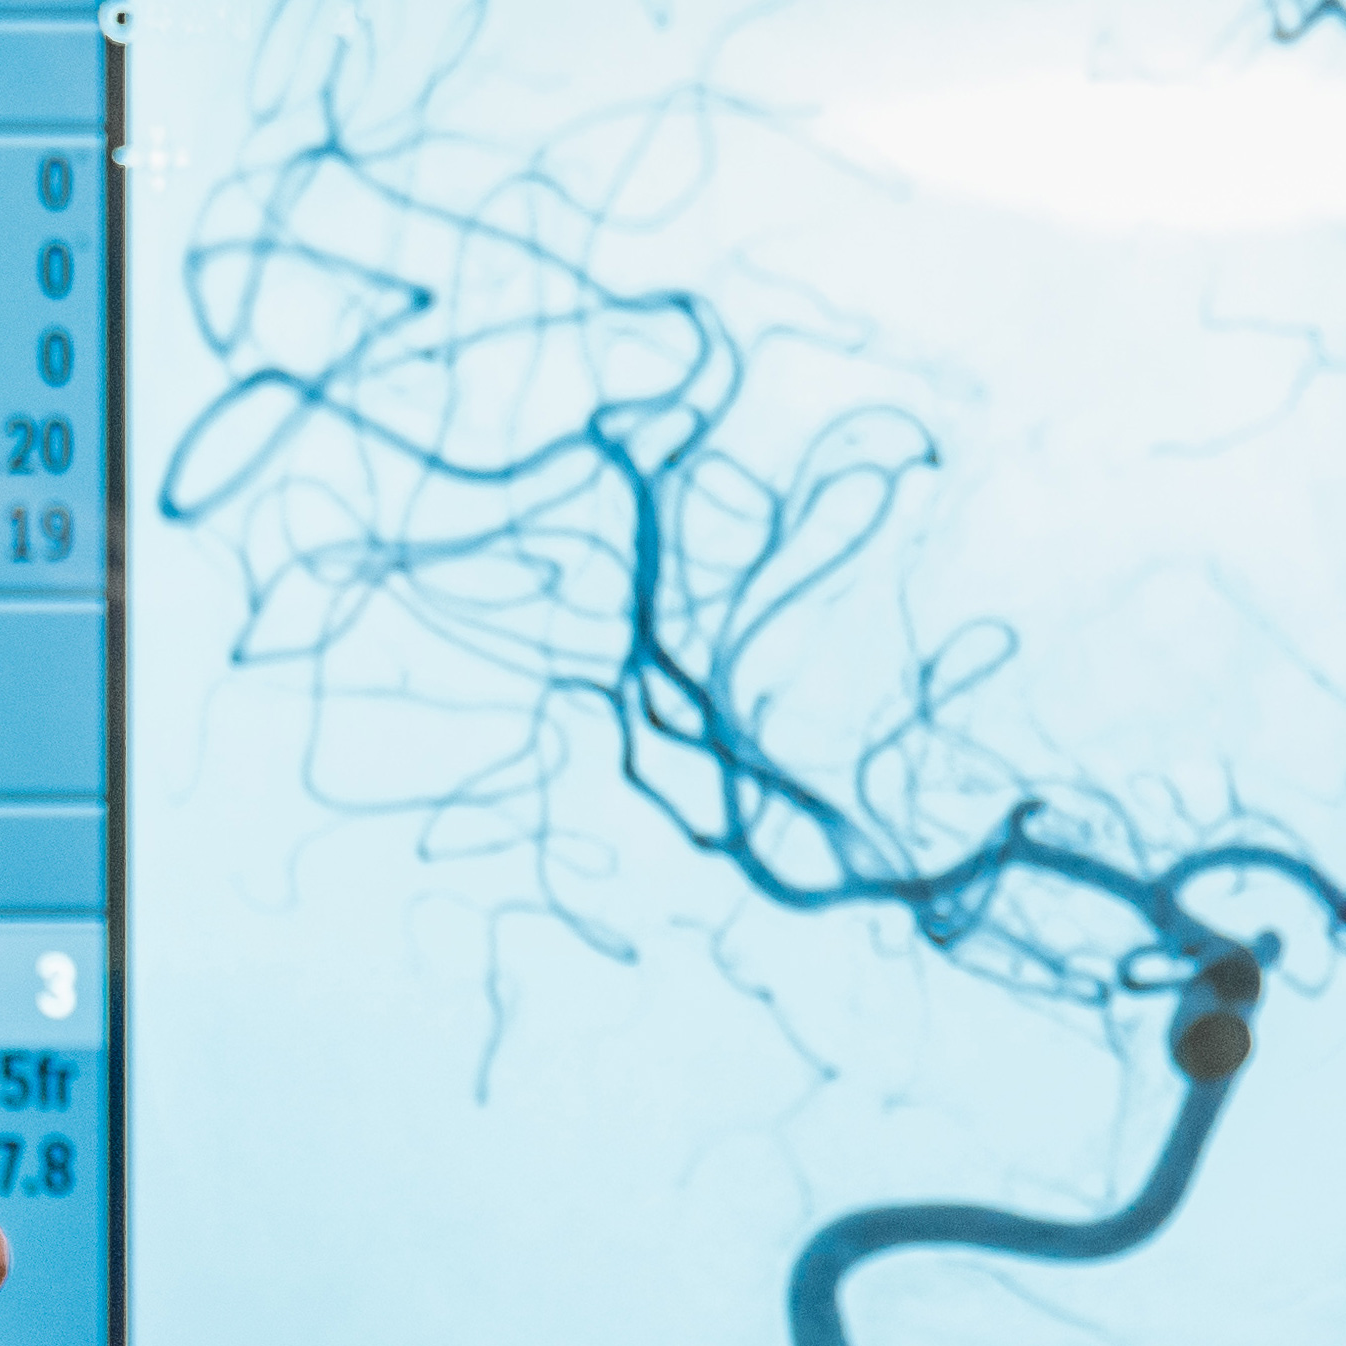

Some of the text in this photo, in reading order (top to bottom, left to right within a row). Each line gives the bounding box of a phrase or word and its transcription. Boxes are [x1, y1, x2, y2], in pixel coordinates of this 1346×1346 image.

[37, 153, 75, 212] 0
[37, 239, 75, 300] 0
[37, 326, 75, 388] 0
[7, 506, 75, 563] 19
[35, 951, 77, 1019] 3
